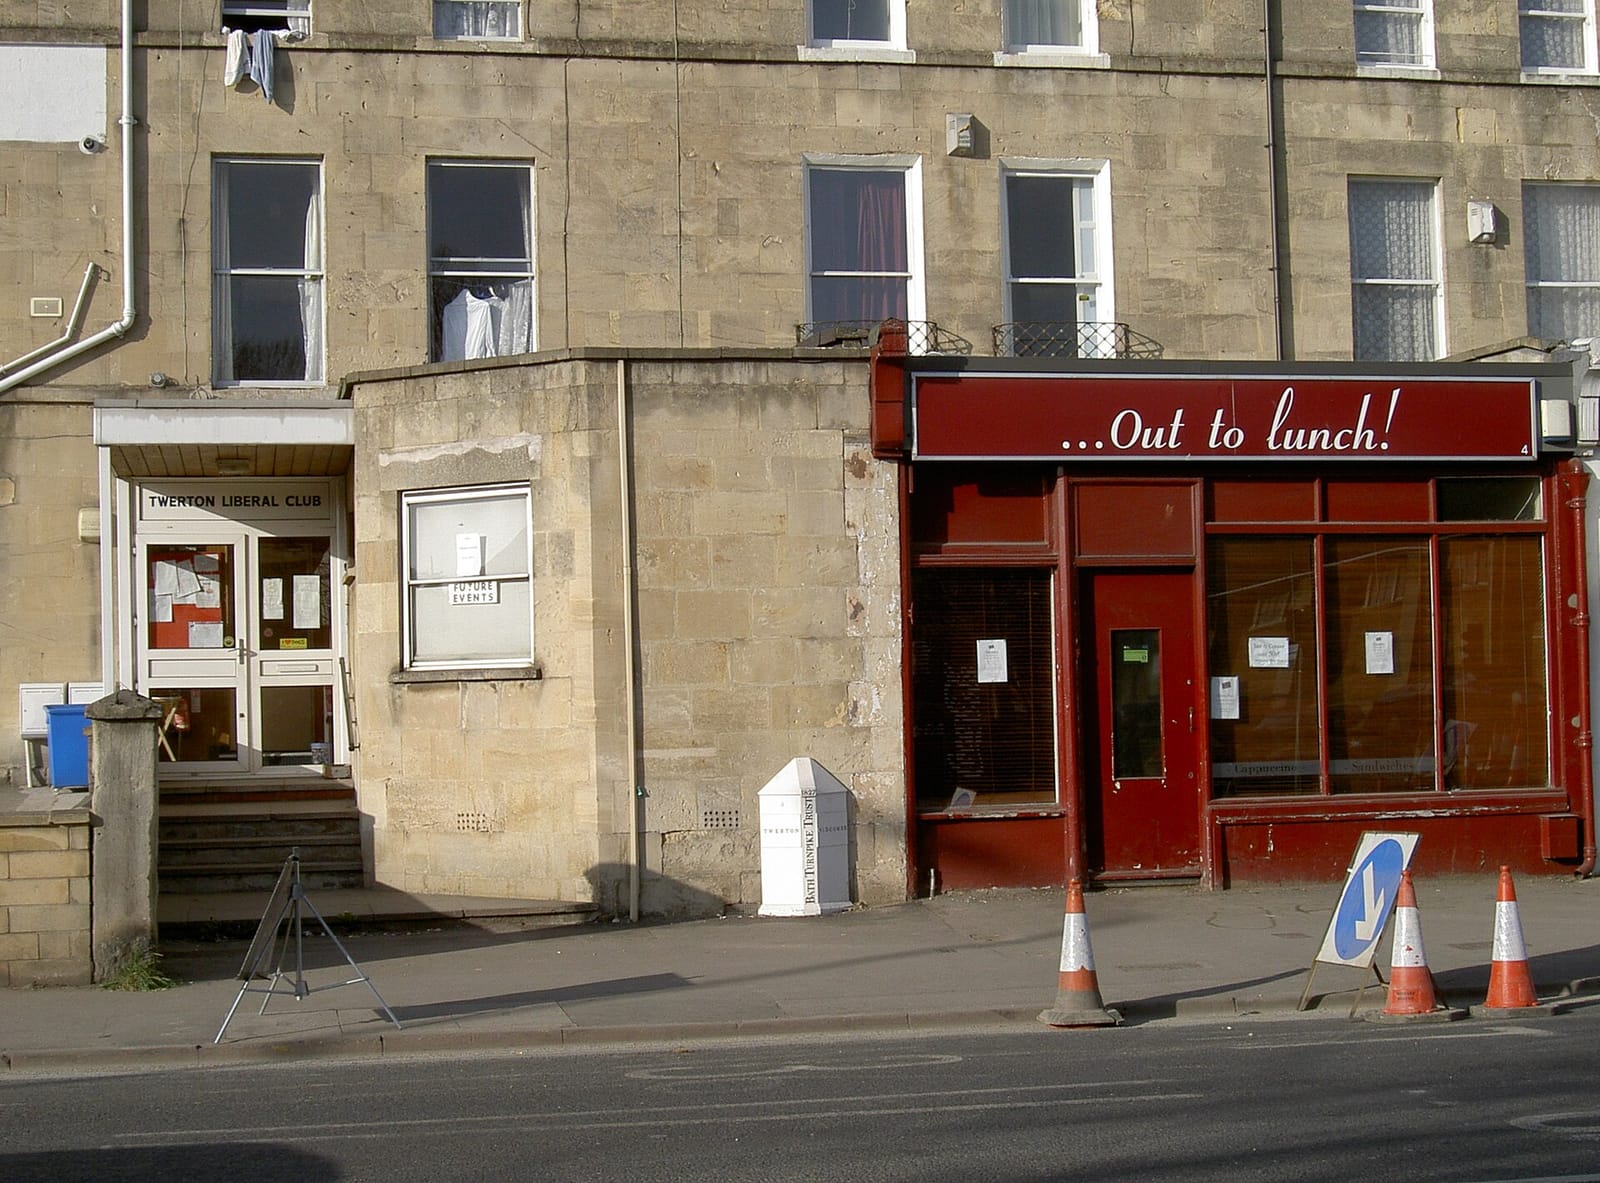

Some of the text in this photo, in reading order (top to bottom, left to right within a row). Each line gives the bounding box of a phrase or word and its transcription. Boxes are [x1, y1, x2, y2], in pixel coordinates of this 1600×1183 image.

[1208, 408, 1245, 449] to
[1266, 386, 1401, 450] lunch!
[1520, 444, 1529, 456] 4
[149, 495, 322, 507] TWERTON LIBERAL CLUB
[453, 581, 493, 592] FUTURE
[453, 593, 494, 603] EVENTS
[802, 798, 816, 905] BATH TURNPIKE TRUST
